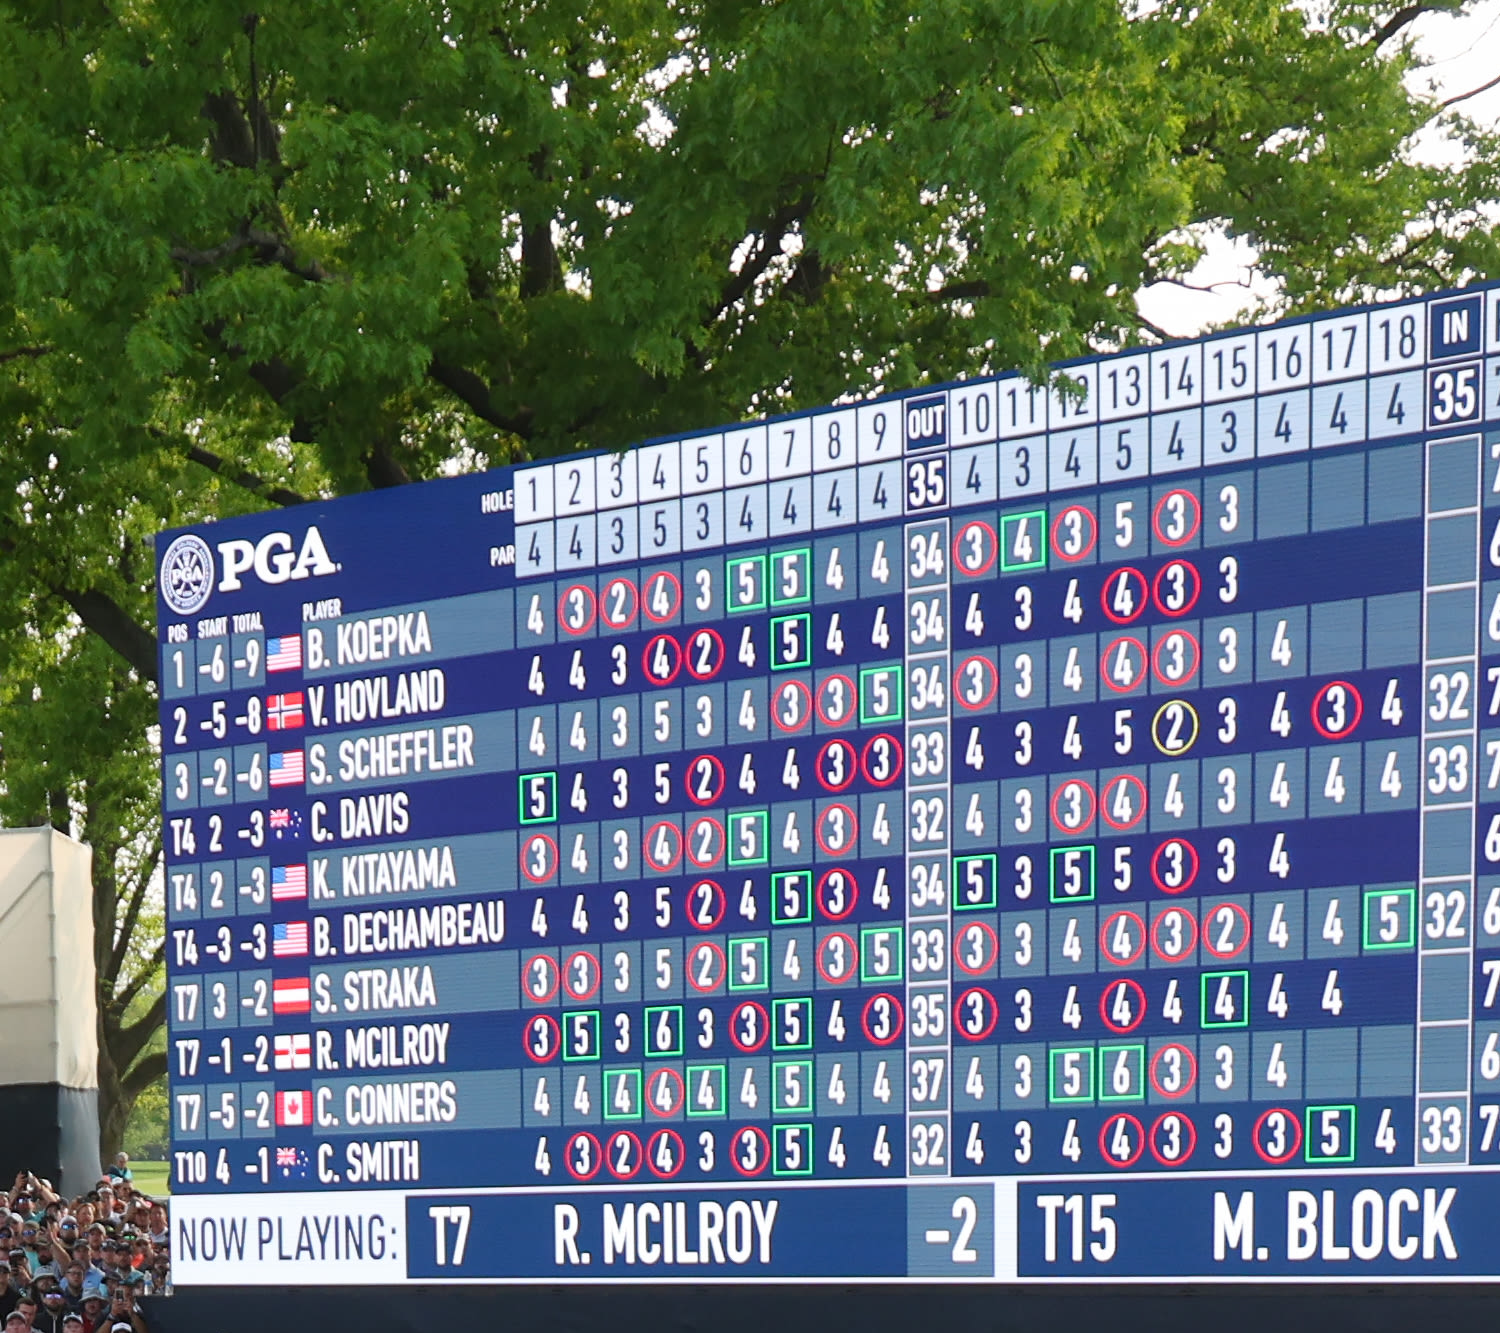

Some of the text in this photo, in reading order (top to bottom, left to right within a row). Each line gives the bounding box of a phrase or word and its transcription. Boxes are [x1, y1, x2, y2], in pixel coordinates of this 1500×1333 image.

[481, 490, 514, 514] HOLE
[908, 405, 945, 439] OUT
[1442, 309, 1469, 345] IN
[490, 545, 515, 567] PAR
[909, 460, 944, 506] 35
[1433, 369, 1476, 422] 35
[172, 567, 202, 584] PGA
[217, 526, 336, 593] PGA
[168, 598, 342, 644] POS START TOTAL PLAYER
[173, 650, 184, 688] 1
[199, 644, 225, 684] -6
[233, 639, 260, 678] -9
[307, 628, 330, 670] B.
[337, 611, 432, 665] KOEPKA
[173, 669, 446, 745] 2 -5 -8 V. HOVLAND
[175, 724, 475, 801] 3 -2 -6 S. SCHEFFLER
[170, 817, 196, 856] T4
[208, 814, 223, 853] 2
[238, 810, 265, 848] -3
[311, 801, 333, 842] C.
[340, 791, 409, 839] DAVIS
[171, 873, 197, 911] T4
[209, 870, 224, 909] 2
[239, 866, 265, 904] -3
[313, 859, 336, 900] K.
[342, 846, 456, 897] KITAYAMA
[173, 900, 505, 966] T4 -3 -3 B. DECHAMBEAU
[174, 984, 198, 1021] T7
[212, 982, 226, 1019] 3
[241, 979, 268, 1017] -2
[314, 973, 338, 1014] S.
[343, 965, 437, 1012] STRAKA
[175, 1022, 450, 1077] T7 -1 -2 R. MCILROY
[176, 1080, 457, 1132] T7 -5 -2 C. CONNERS
[174, 1151, 207, 1184] T10
[215, 1148, 230, 1185] 4
[244, 1146, 269, 1184] -1
[318, 1143, 340, 1184] C.
[346, 1140, 420, 1181] SMITH
[1422, 1106, 1462, 1153] 33
[178, 1217, 253, 1263] NOW
[258, 1213, 400, 1263] PLAYING:
[429, 1205, 473, 1266] T7
[553, 1204, 592, 1265] R.
[604, 1198, 780, 1265] MCILROY
[925, 1196, 978, 1263] -2
[1036, 1194, 1118, 1263] T15
[1212, 1191, 1269, 1261] M.
[1286, 1187, 1459, 1261] BLOCK
